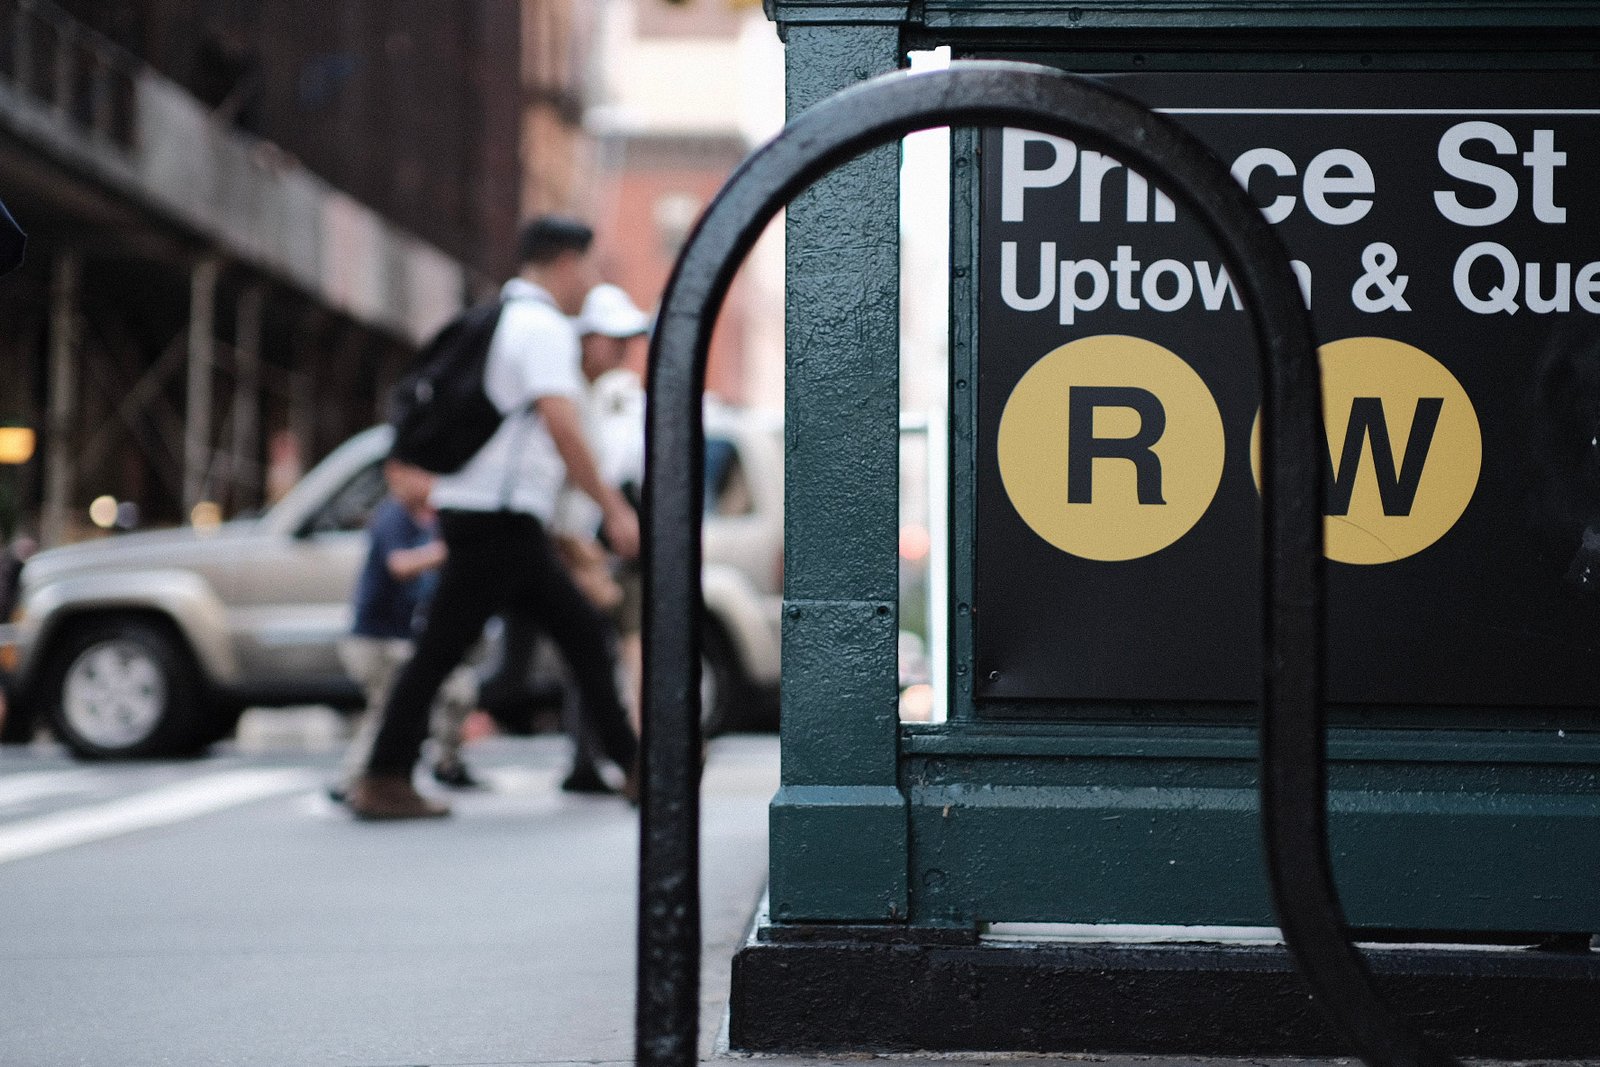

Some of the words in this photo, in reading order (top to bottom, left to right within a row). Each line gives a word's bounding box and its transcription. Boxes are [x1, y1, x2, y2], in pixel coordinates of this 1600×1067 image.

[1002, 128, 1375, 225] Price
[1434, 121, 1566, 226] St
[1352, 242, 1411, 312] &
[1068, 386, 1166, 505] R
[1322, 397, 1445, 517] W
